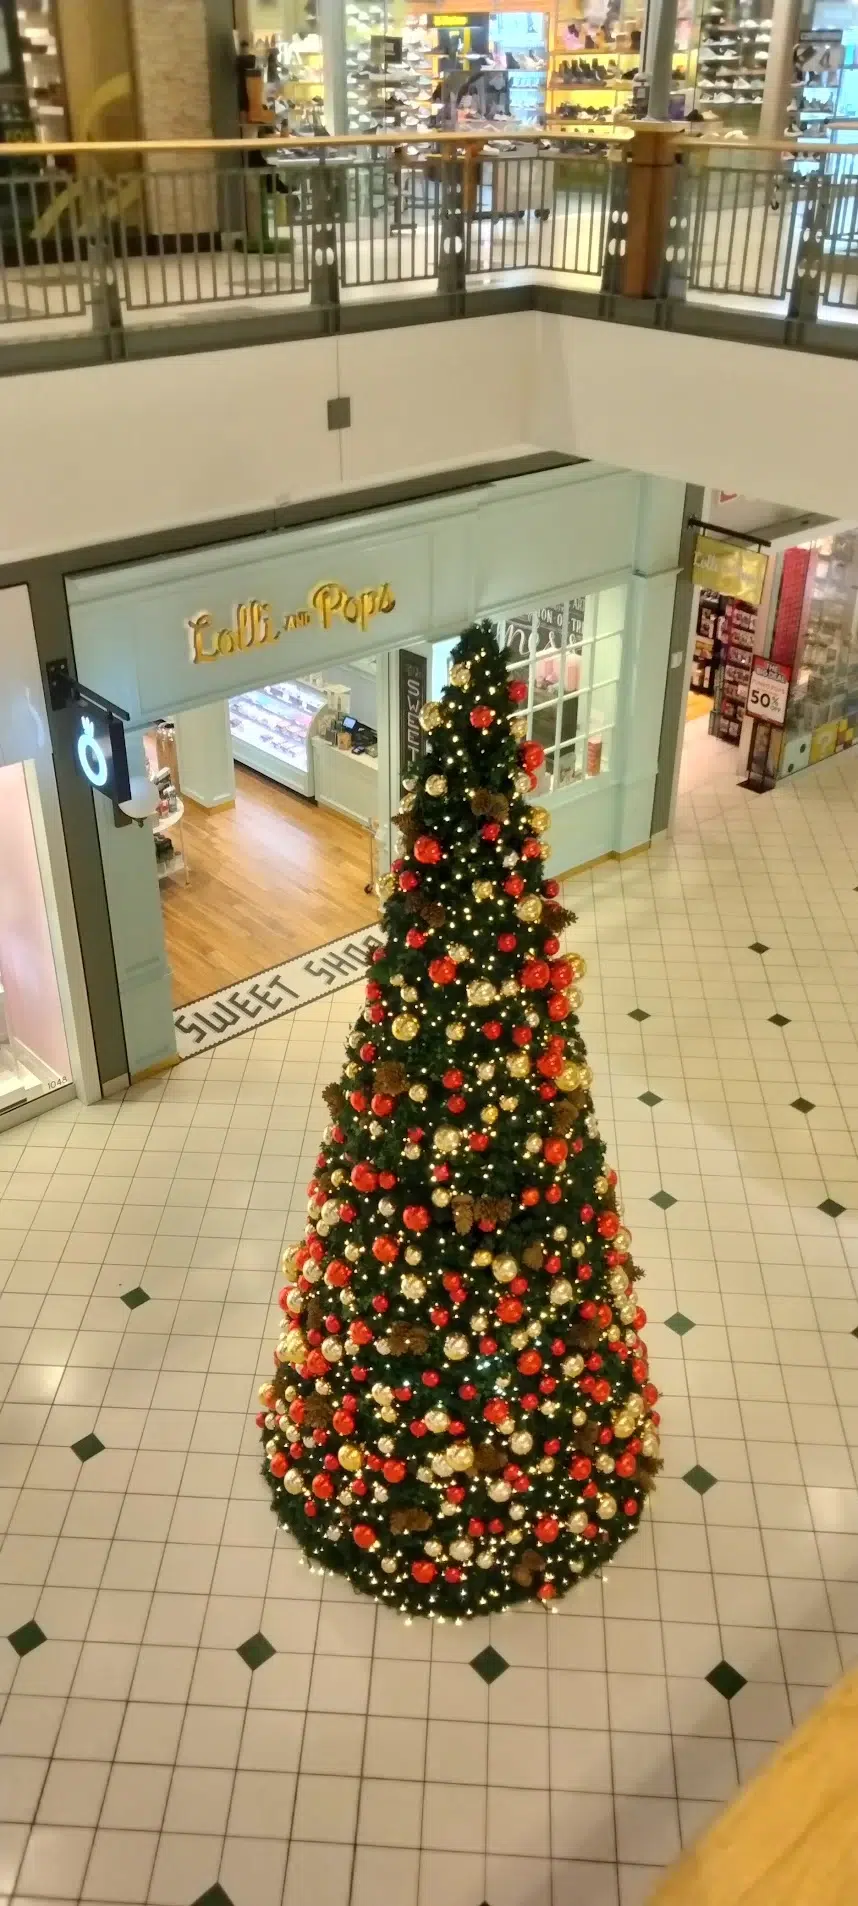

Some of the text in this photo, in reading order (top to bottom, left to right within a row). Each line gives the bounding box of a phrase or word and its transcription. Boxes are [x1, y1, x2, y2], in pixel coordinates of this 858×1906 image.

[186, 580, 397, 664] Lolli AND Pops
[407, 679, 420, 762] SWEET
[174, 974, 300, 1044] SWEET
